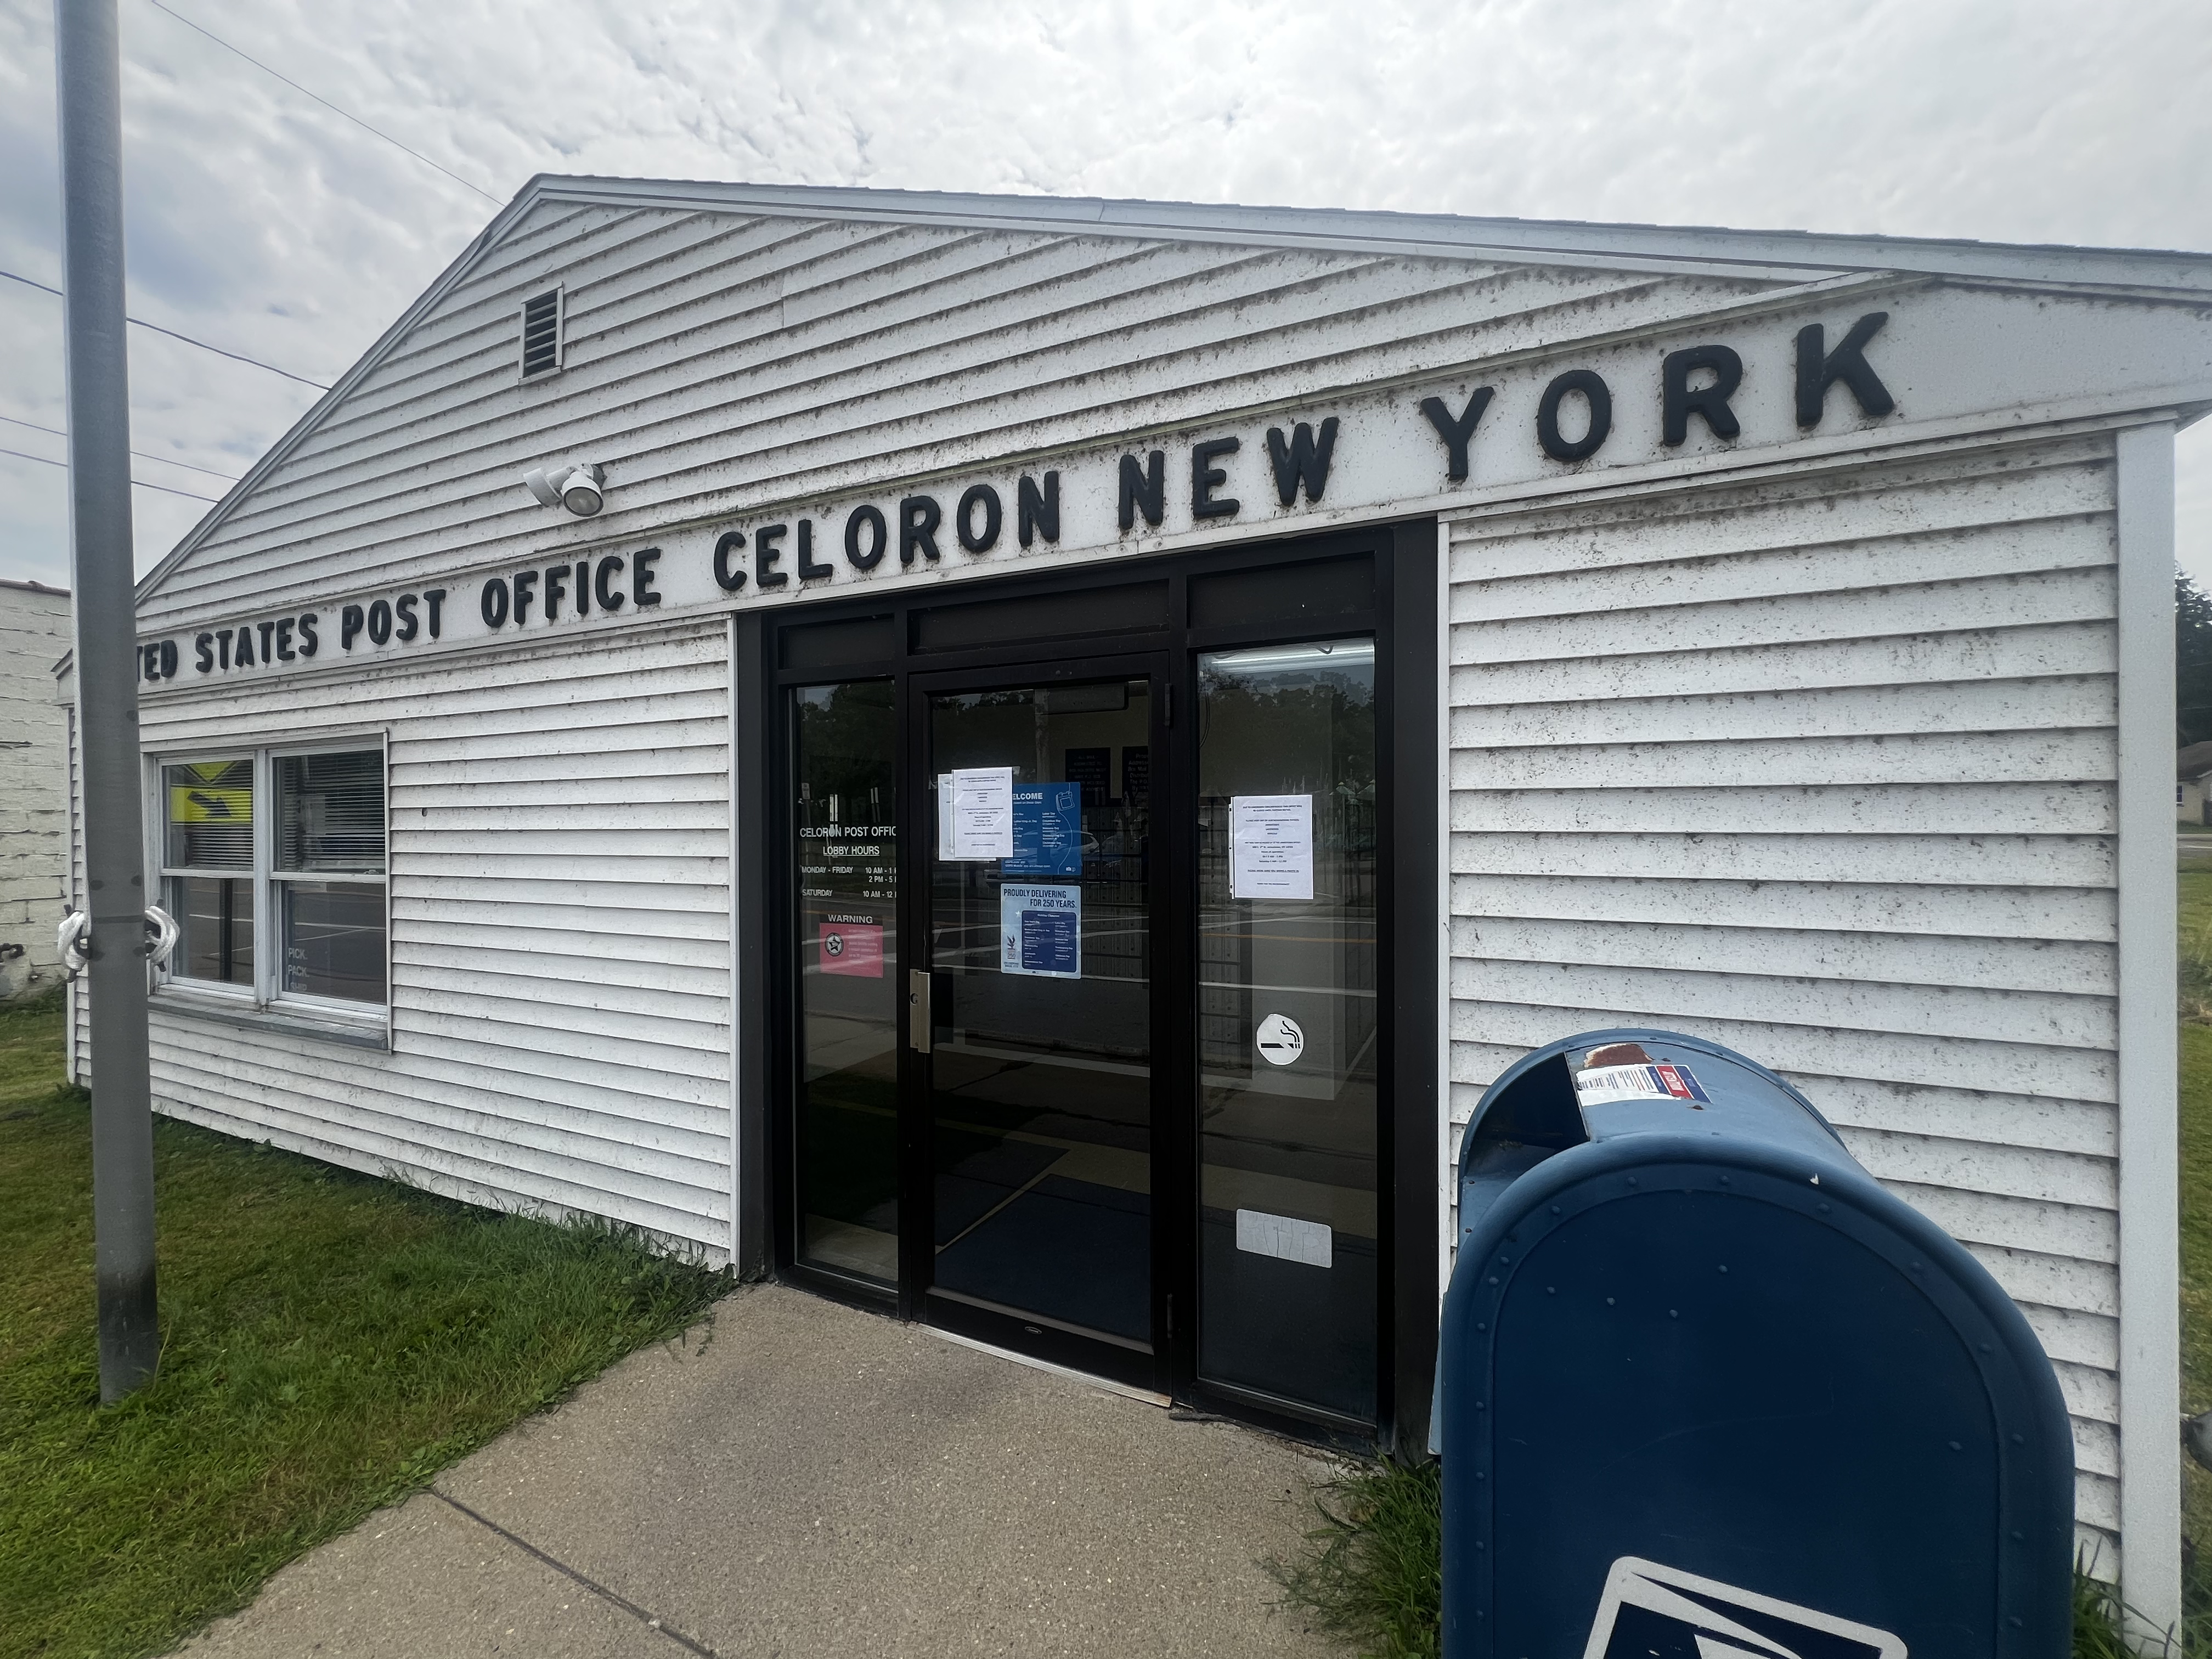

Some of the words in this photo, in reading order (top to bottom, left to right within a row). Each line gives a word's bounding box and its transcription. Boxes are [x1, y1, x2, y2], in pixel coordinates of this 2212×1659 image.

[195, 613, 318, 674] STATES
[342, 589, 447, 650] POST
[481, 549, 663, 628] OFFICE
[713, 470, 1061, 591] CELORON
[1118, 416, 1339, 530] NEW
[1421, 311, 1895, 482] YORK
[800, 827, 842, 837] CELORON
[845, 826, 868, 837] POST
[823, 846, 849, 855] LOBBY
[851, 846, 880, 855] HOURS
[1003, 889, 1030, 897] PROUDLY
[1031, 889, 1066, 899] DELIVERING
[1030, 899, 1042, 907] FOR
[828, 914, 873, 923] WARNING
[287, 964, 310, 978] PACK.
